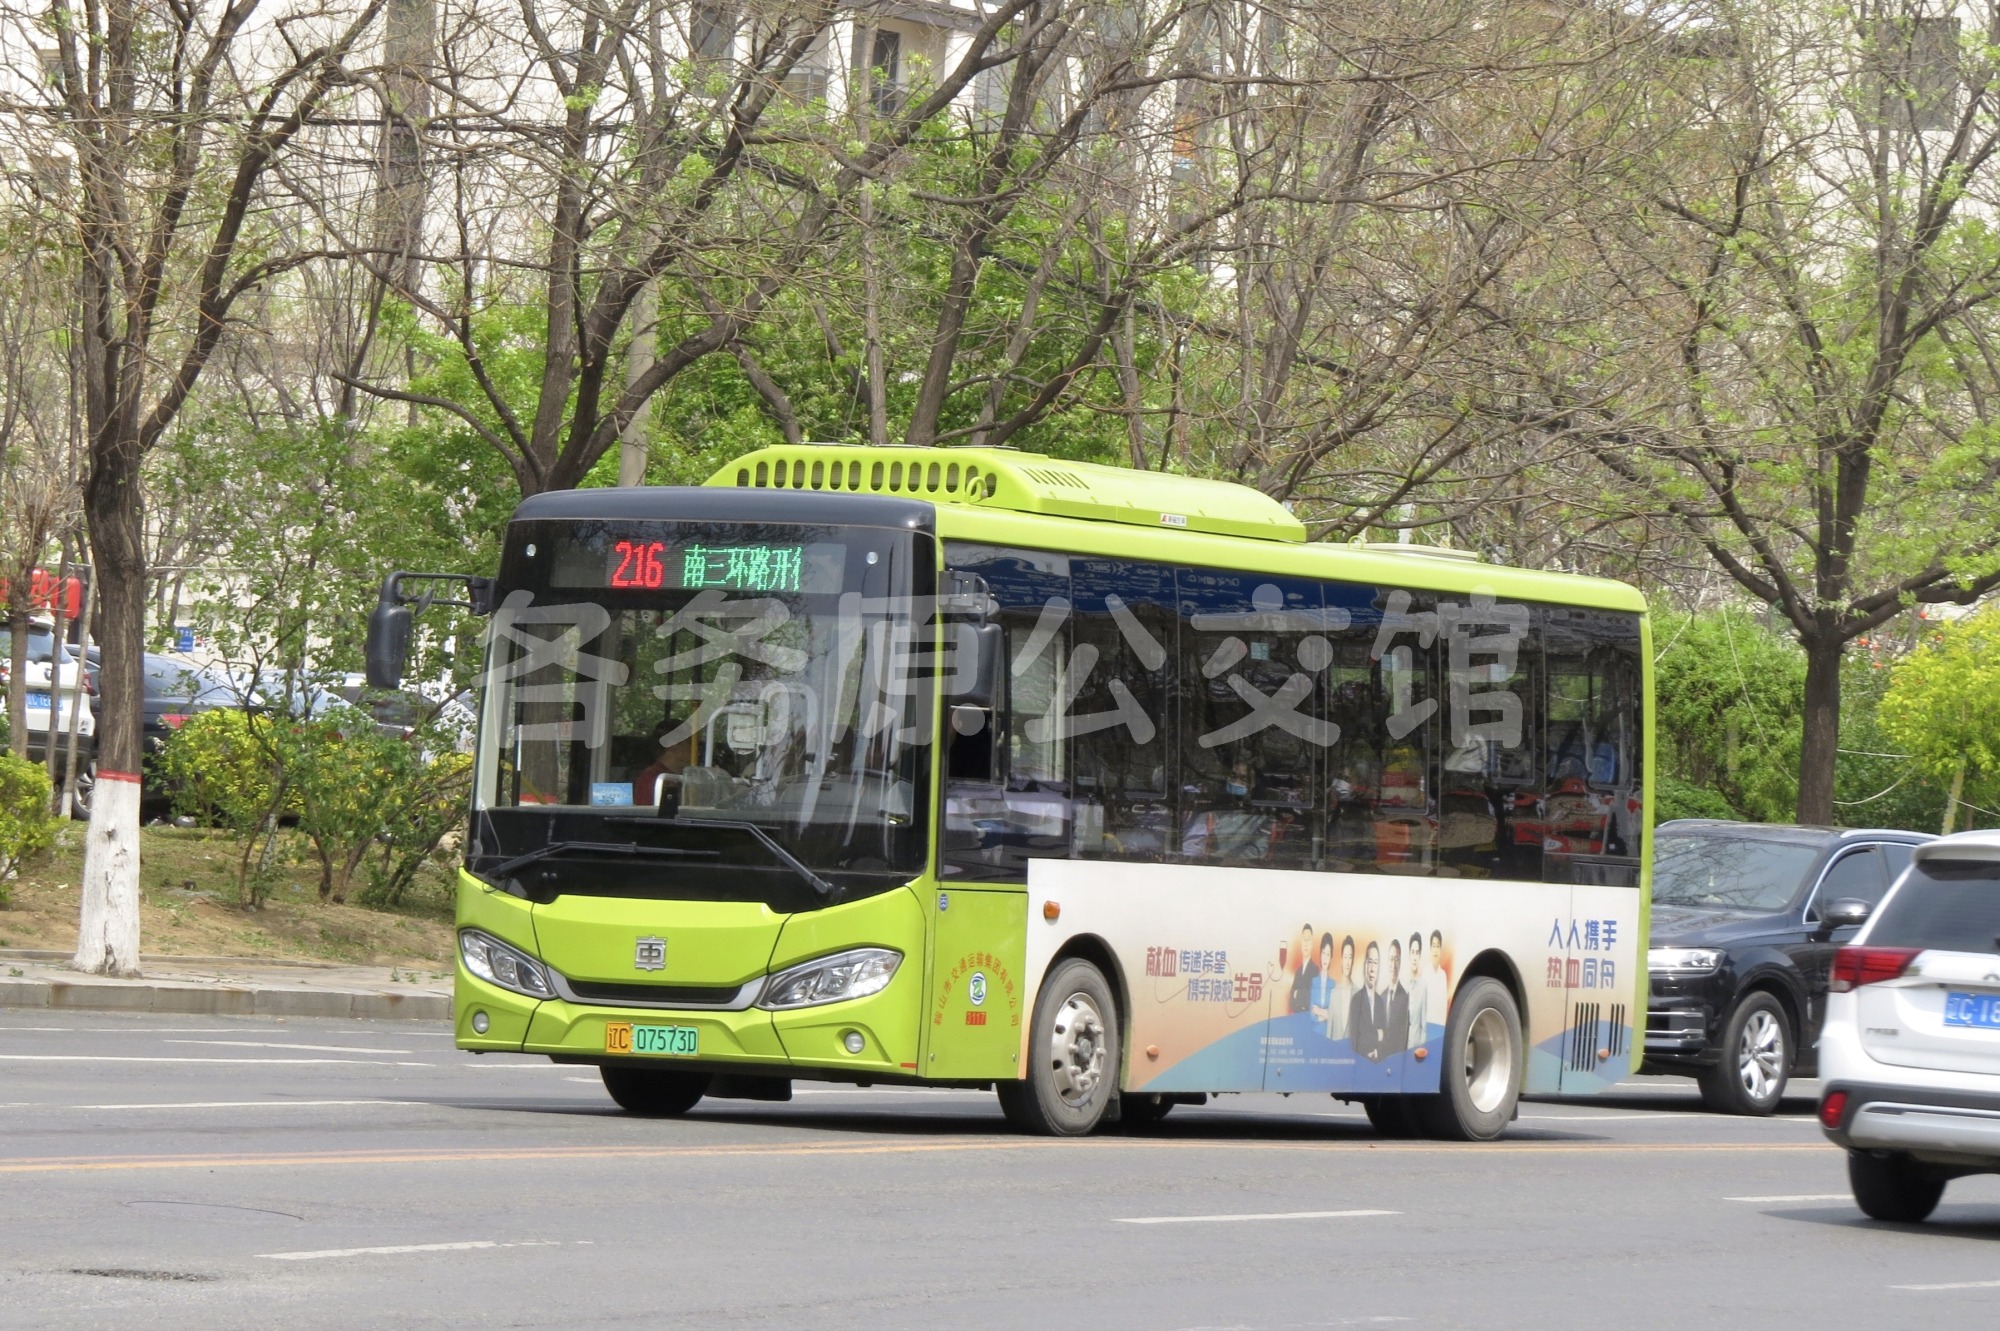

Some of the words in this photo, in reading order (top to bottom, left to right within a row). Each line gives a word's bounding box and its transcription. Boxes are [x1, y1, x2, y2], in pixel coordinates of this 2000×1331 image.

[612, 541, 665, 588] 216
[1549, 918, 1617, 951] 人人携手
[1547, 957, 1615, 989] 热血同舟
